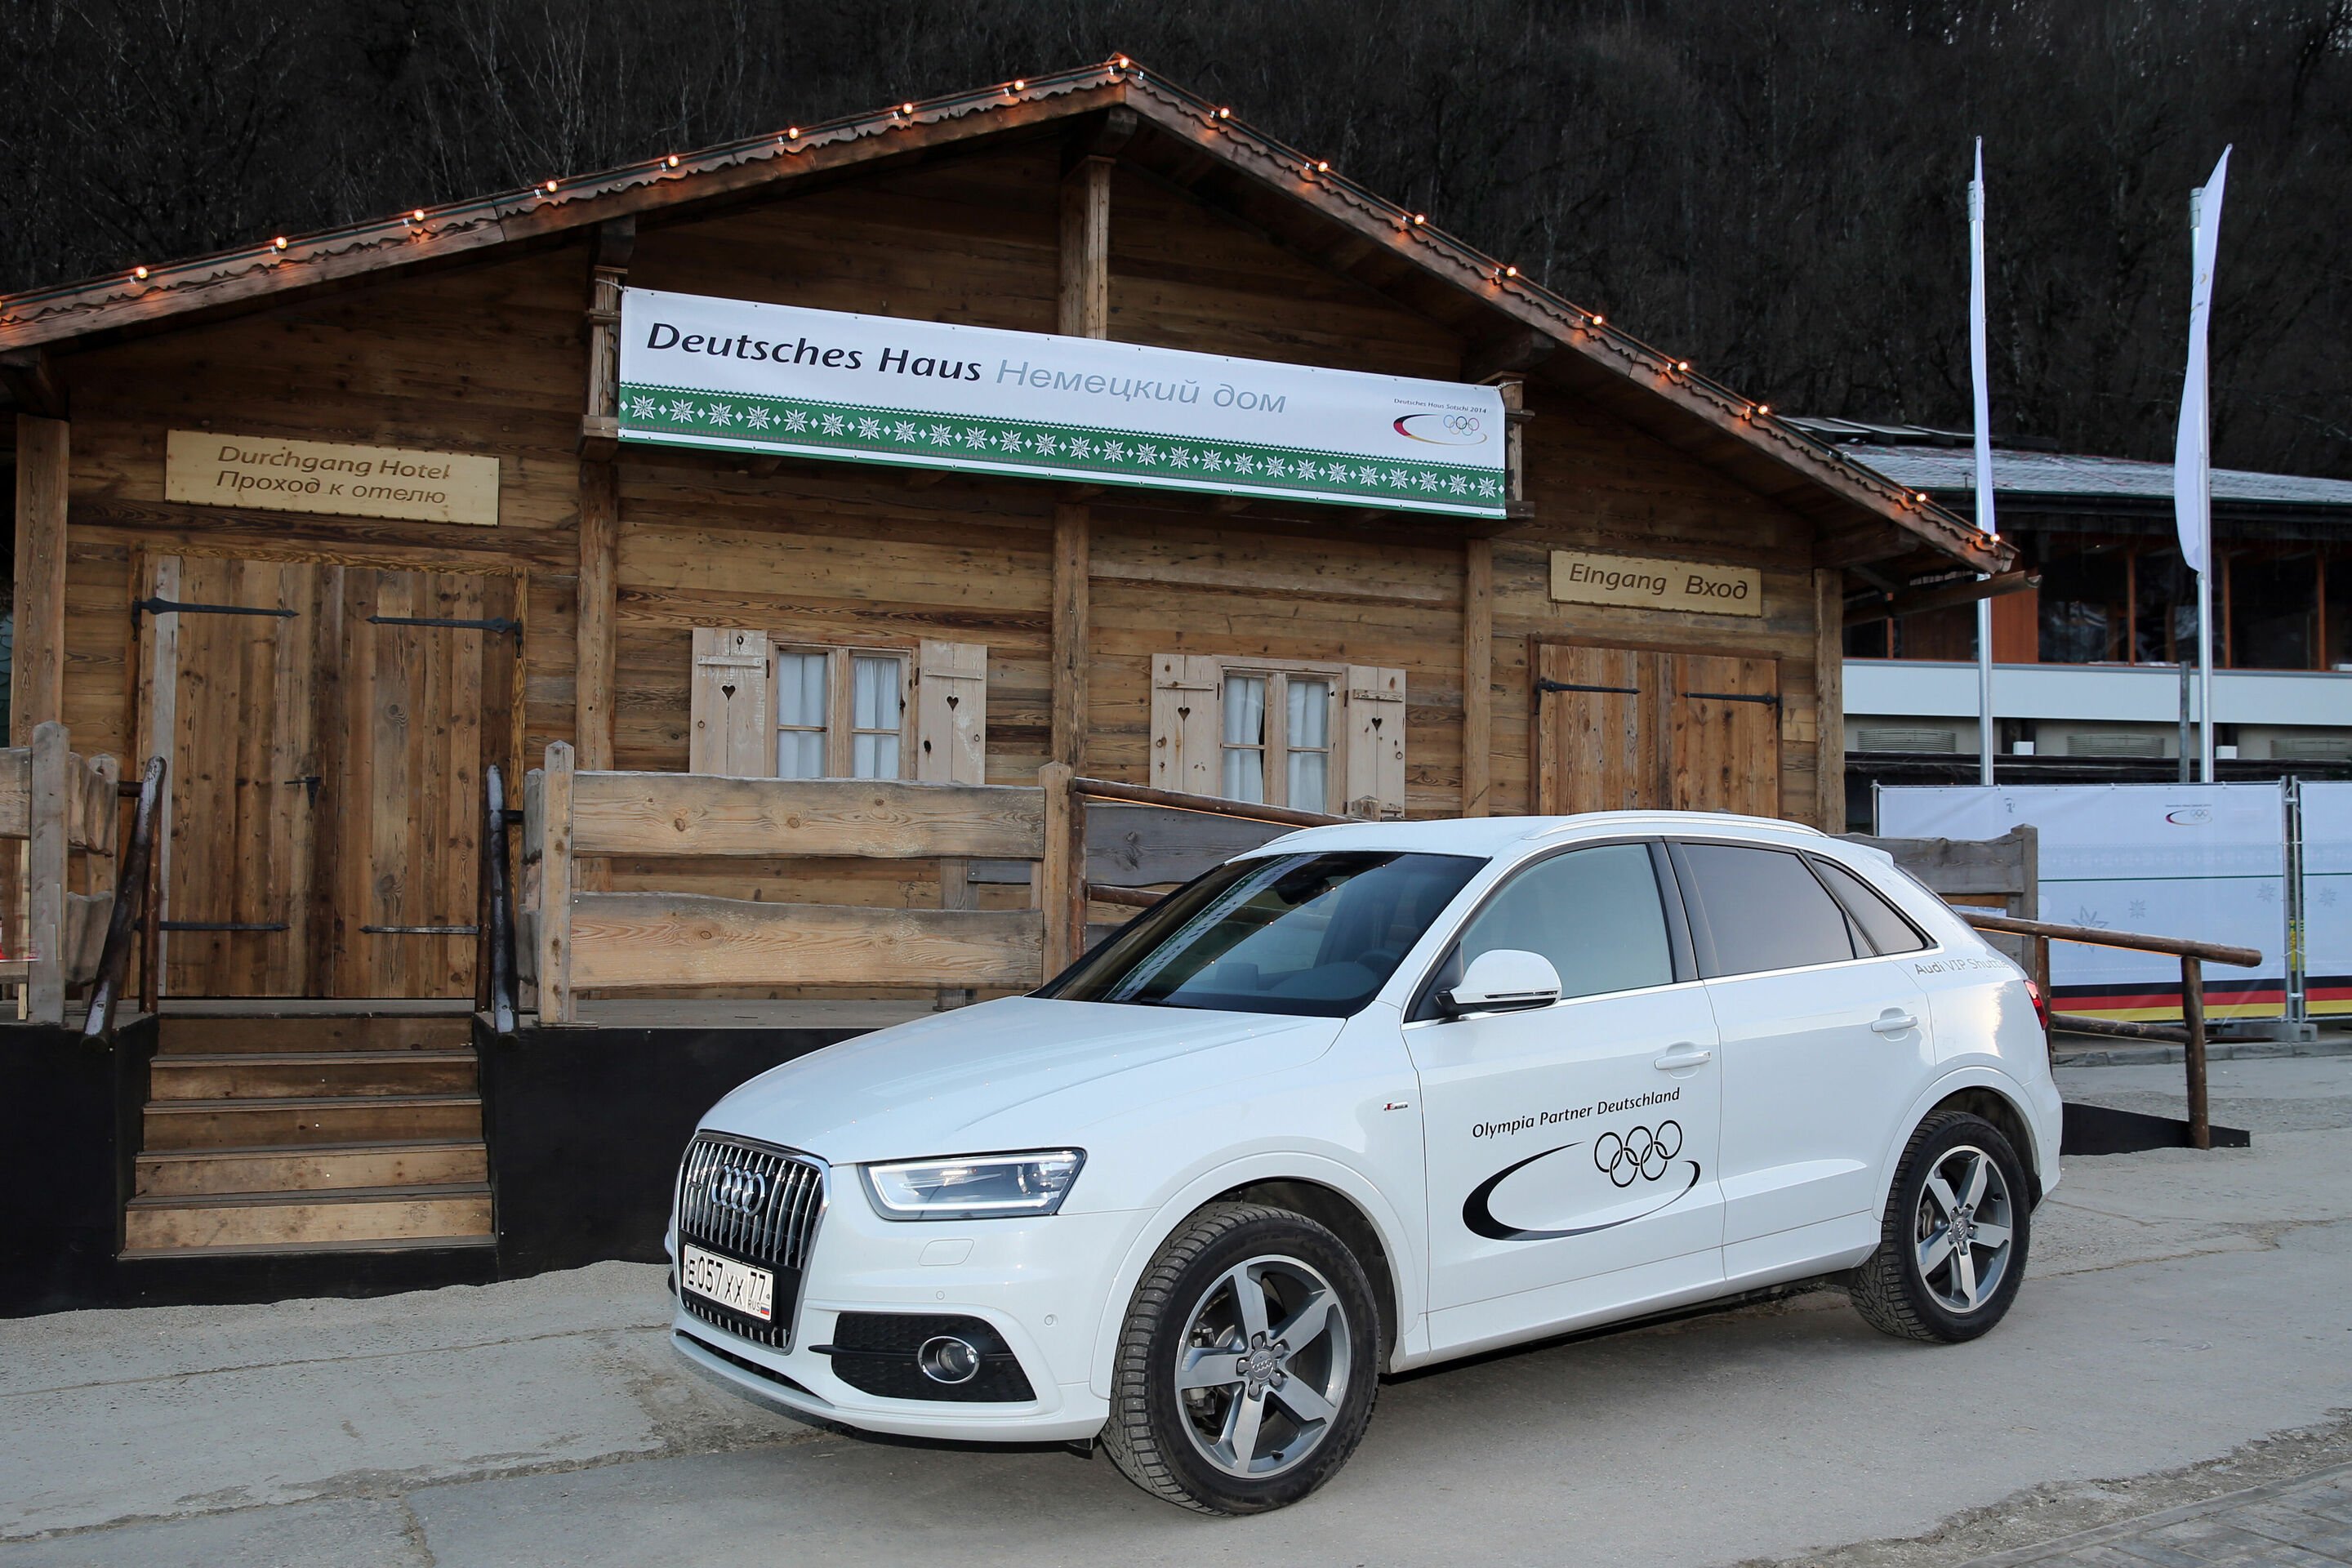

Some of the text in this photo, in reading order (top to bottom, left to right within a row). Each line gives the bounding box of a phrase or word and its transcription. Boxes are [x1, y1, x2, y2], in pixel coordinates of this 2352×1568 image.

[647, 323, 982, 381] Deutsches Haus
[996, 359, 1286, 413] Немецкий дом
[1394, 398, 1426, 407] Deutsches
[1446, 403, 1468, 412] Sotschi
[217, 445, 452, 480] Durchgang Hotel
[216, 470, 321, 494] Проход
[351, 486, 446, 505] отелю
[1569, 563, 1667, 595] Eingang
[1685, 575, 1748, 599] Вход
[1914, 961, 1945, 975] Audi
[1944, 959, 1966, 971] VIP
[1472, 1087, 1681, 1139] Olympia Partner Deutschland
[747, 1299, 761, 1312] RUS
